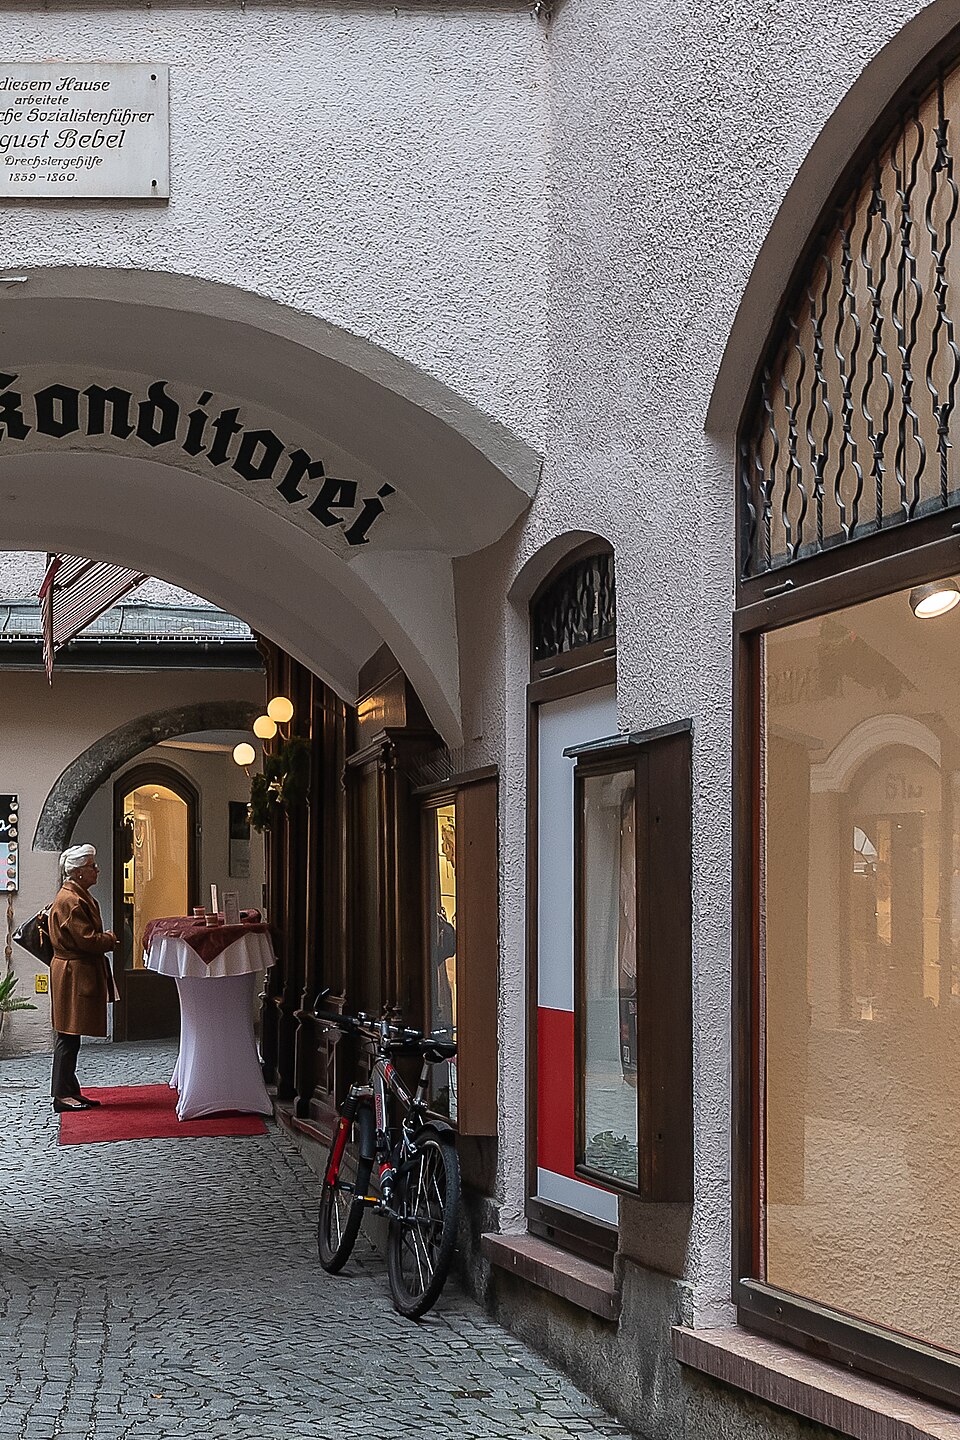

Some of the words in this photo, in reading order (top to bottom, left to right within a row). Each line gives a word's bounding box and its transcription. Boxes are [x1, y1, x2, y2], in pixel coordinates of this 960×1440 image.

[55, 76, 111, 92] Hause
[14, 94, 69, 106] arbeitete
[26, 108, 155, 126] Sozialistenführer
[54, 128, 127, 149] Bebel
[4, 155, 103, 170] Drechslergehilfe
